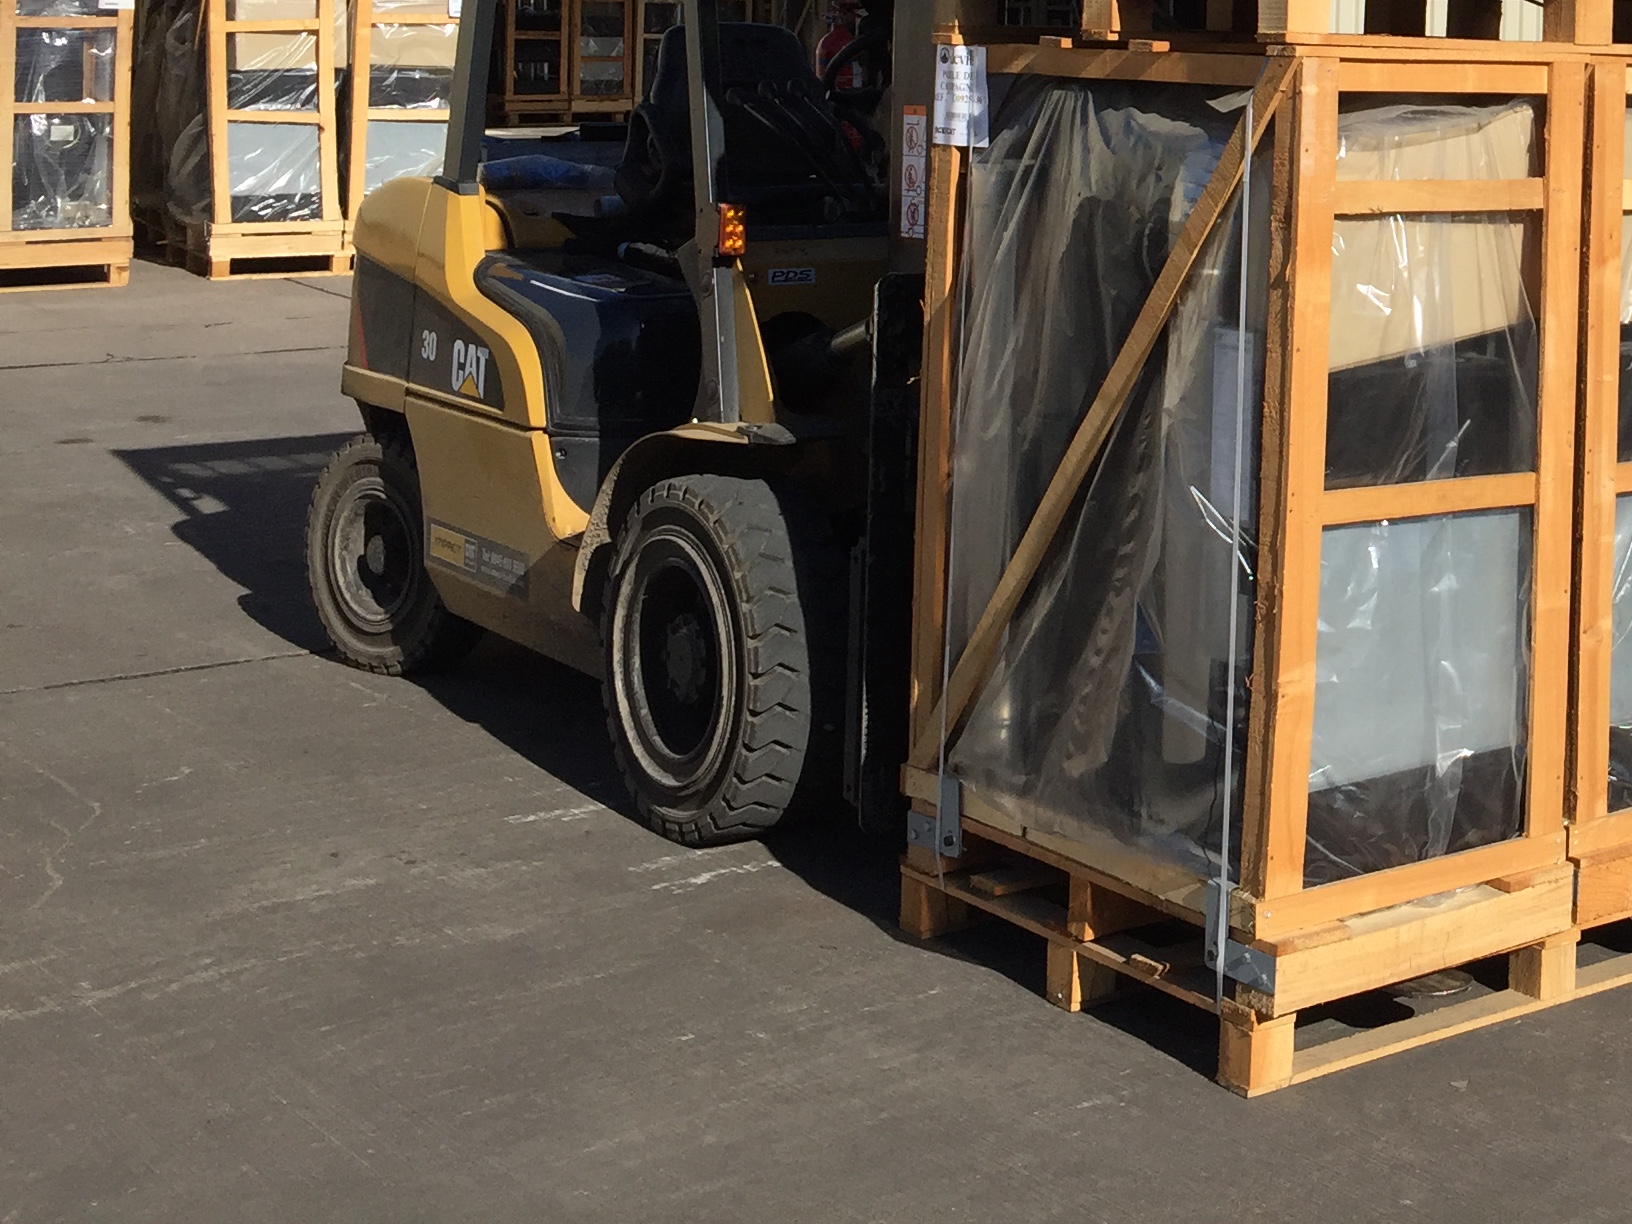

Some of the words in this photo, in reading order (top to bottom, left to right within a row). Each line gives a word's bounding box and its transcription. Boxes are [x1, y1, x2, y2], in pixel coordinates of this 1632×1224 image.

[771, 269, 813, 283] PDS
[421, 329, 437, 361] 30
[452, 339, 489, 400] CAT
